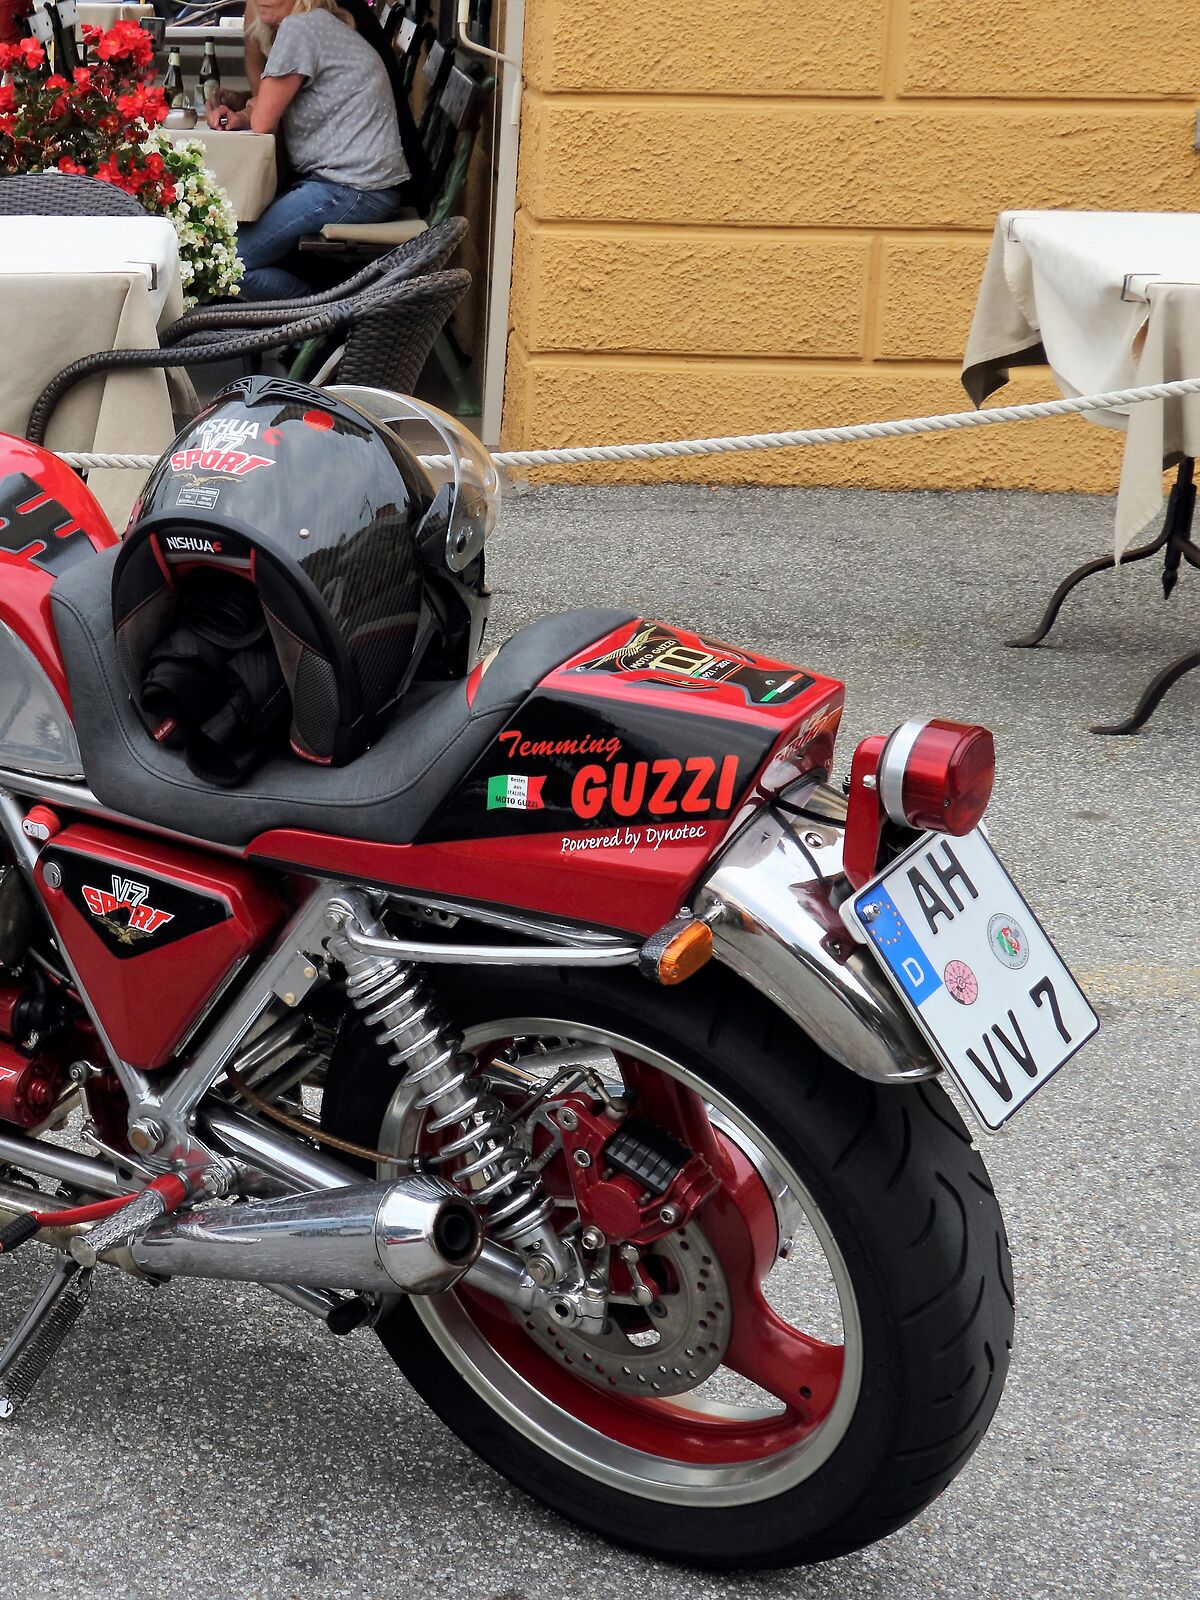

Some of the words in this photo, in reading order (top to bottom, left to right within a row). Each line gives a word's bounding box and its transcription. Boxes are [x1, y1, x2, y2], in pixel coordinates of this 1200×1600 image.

[189, 419, 259, 439] NISHUA
[201, 433, 247, 454] V7
[170, 448, 276, 475] SPORT
[166, 537, 214, 553] NISHUA
[499, 730, 622, 761] Temming
[495, 795, 515, 804] MOTO
[571, 755, 739, 819] GUZZI
[561, 828, 622, 852] Powered
[624, 827, 641, 853] by
[646, 824, 706, 853] Dynotec
[111, 874, 150, 907] V7
[906, 839, 978, 934] AH
[902, 957, 924, 987] D
[965, 1009, 1038, 1103] VV
[1029, 976, 1072, 1044] 7
